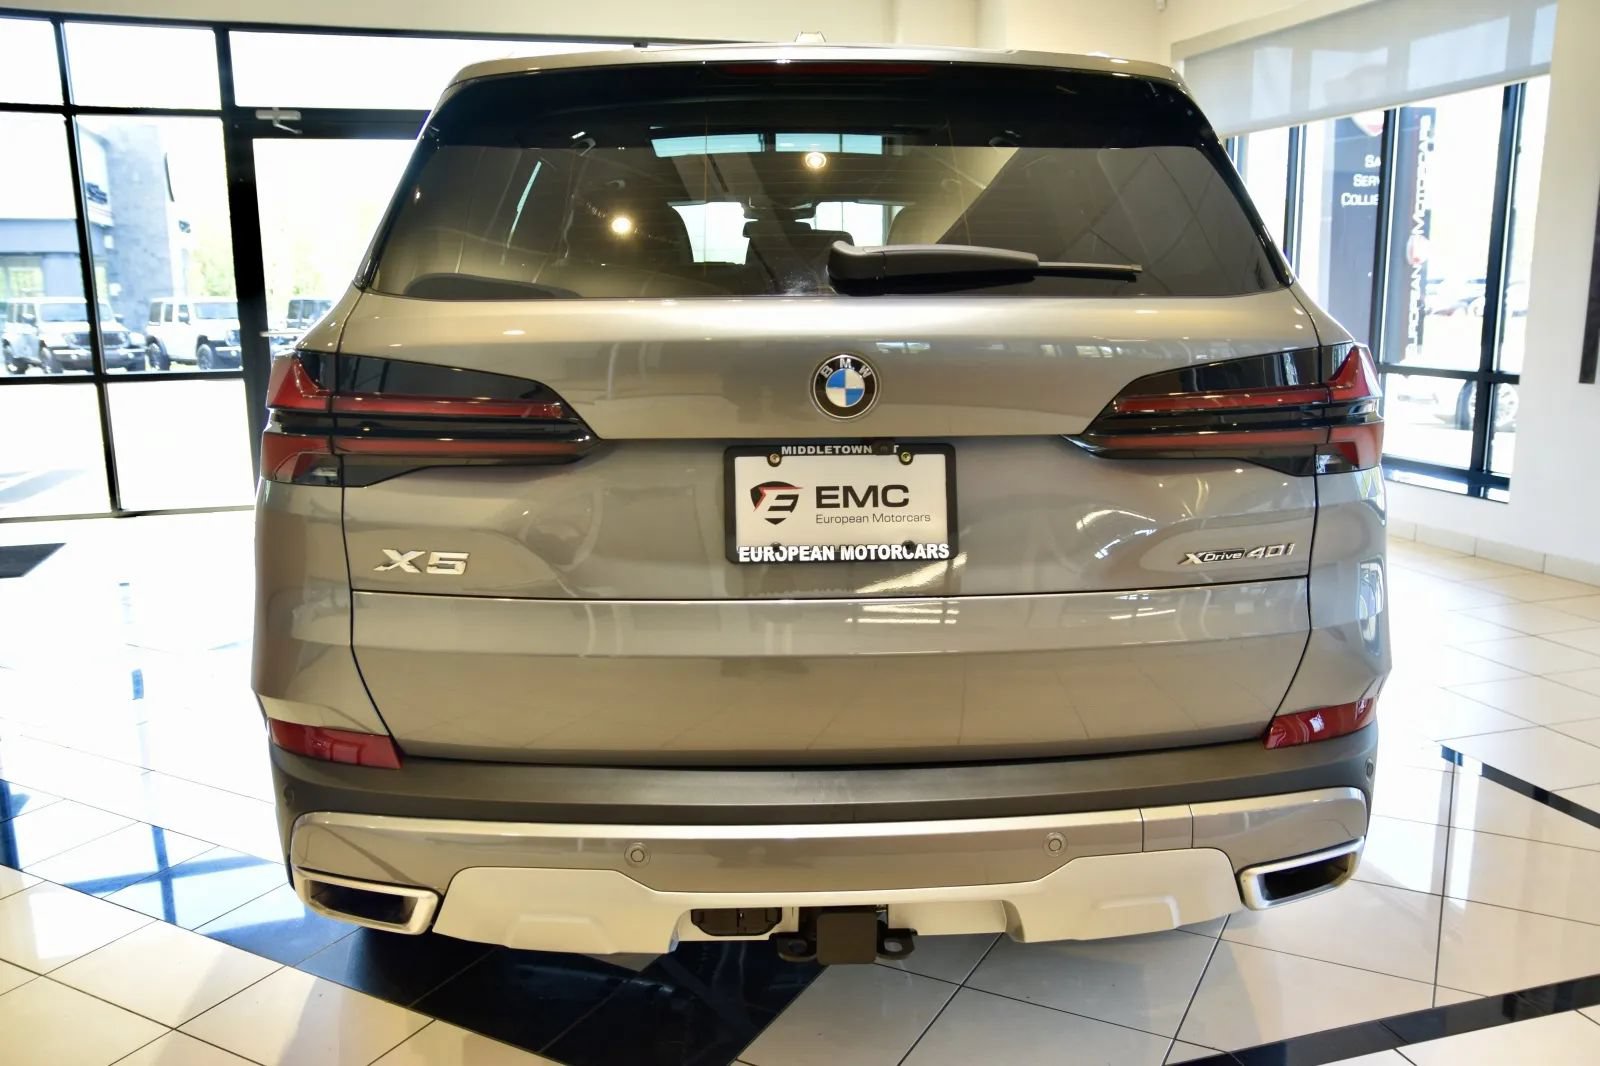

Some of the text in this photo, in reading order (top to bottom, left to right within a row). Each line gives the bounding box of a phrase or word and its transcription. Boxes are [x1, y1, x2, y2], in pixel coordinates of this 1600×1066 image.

[820, 357, 872, 379] BMW
[781, 445, 872, 455] MIDDLETOWN
[815, 485, 909, 508] EMC
[815, 513, 931, 526] European Motorcars
[373, 549, 470, 575] X5
[738, 546, 834, 562] EUROPEAN
